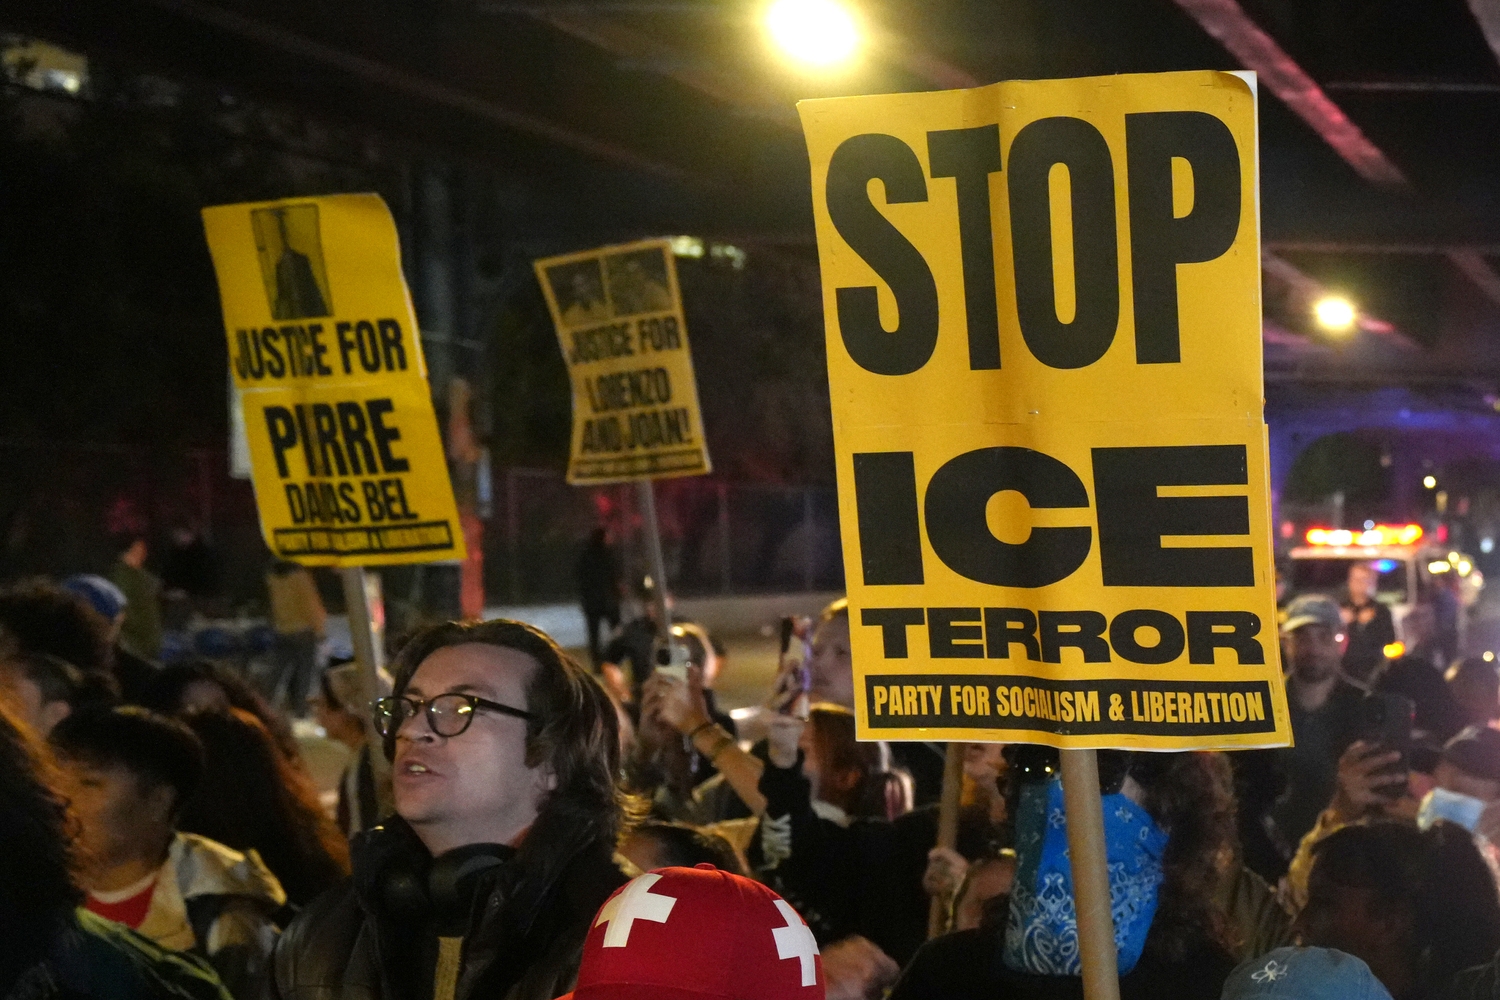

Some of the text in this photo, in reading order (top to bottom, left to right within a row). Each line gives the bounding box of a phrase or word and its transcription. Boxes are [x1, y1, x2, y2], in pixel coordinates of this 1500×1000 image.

[825, 110, 1241, 376] STOP
[335, 318, 407, 374] FOR
[637, 316, 682, 353] FOR
[361, 478, 419, 522] BEL
[852, 444, 1255, 588] ICE
[861, 607, 1265, 665] TERROR
[873, 685, 1265, 723] PARTY FOR SOCIALISM & LIBERATION
